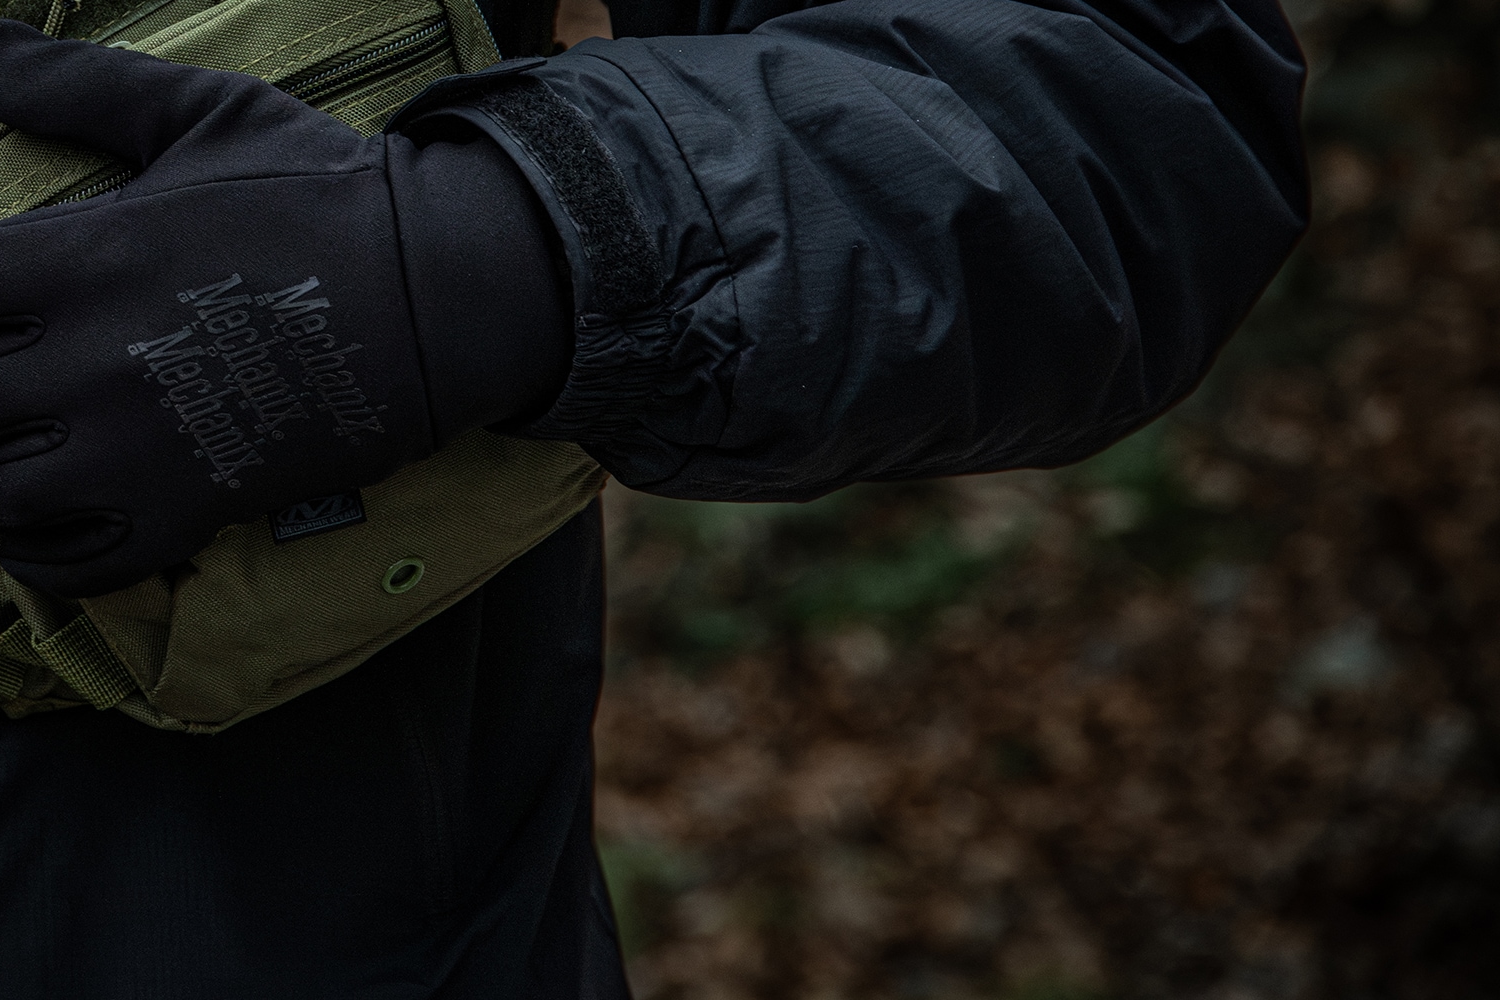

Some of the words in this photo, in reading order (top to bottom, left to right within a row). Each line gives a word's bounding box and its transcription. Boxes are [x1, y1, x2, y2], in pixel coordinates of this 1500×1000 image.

[138, 324, 266, 481] Mechanix
[190, 272, 309, 432] Mechanix
[268, 275, 389, 435] Mechanix
